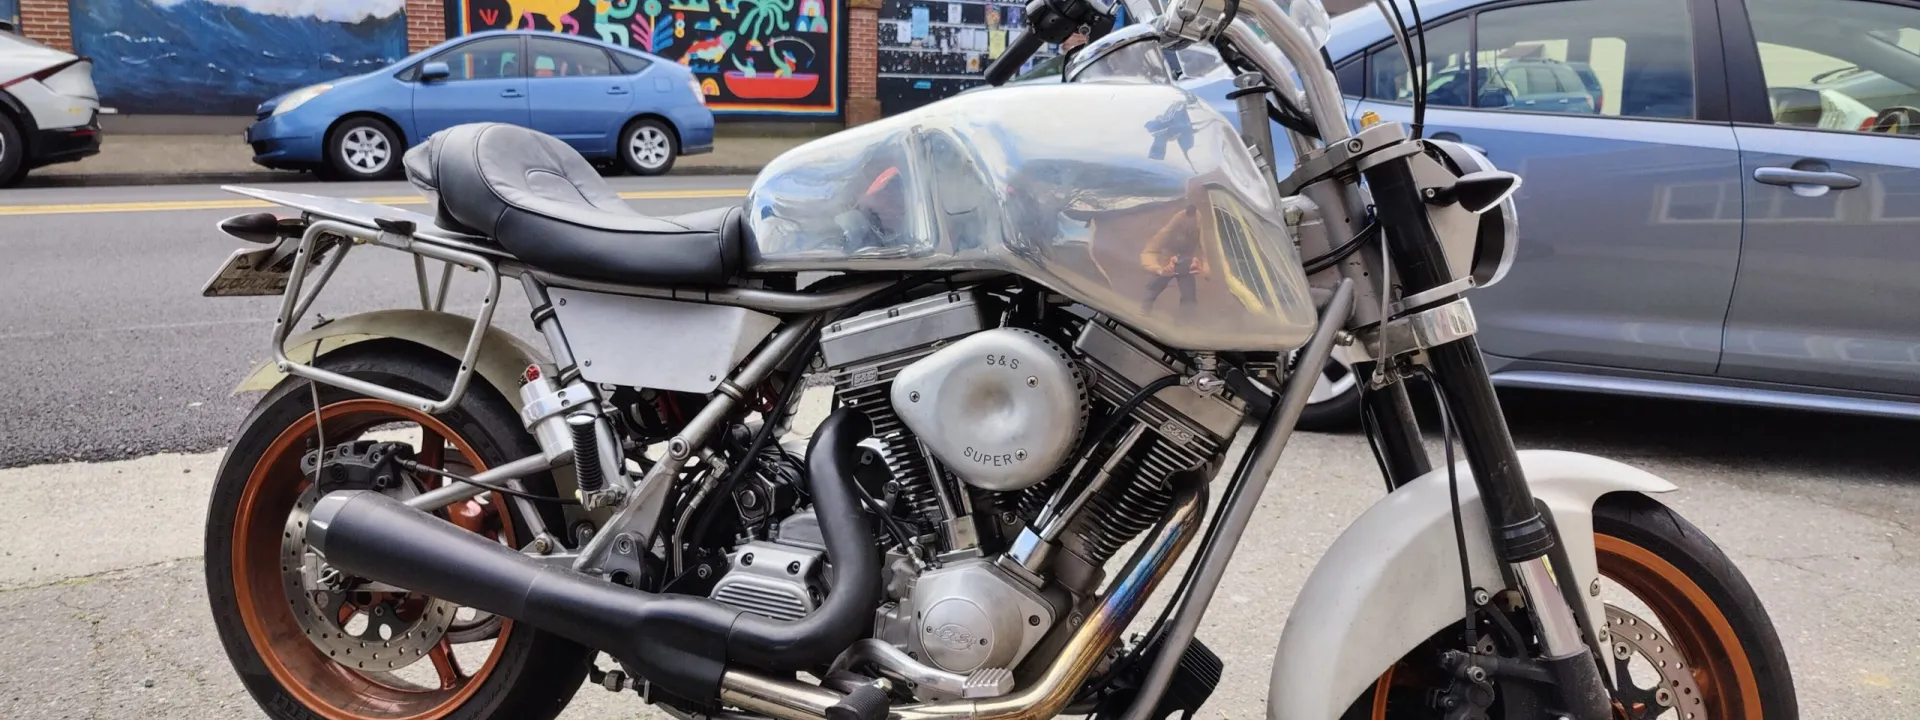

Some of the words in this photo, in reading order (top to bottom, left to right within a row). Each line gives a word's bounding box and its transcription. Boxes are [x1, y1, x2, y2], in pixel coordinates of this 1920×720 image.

[986, 354, 1020, 370] S&S
[1163, 423, 1190, 441] S&S
[963, 446, 1013, 467] SUPER
